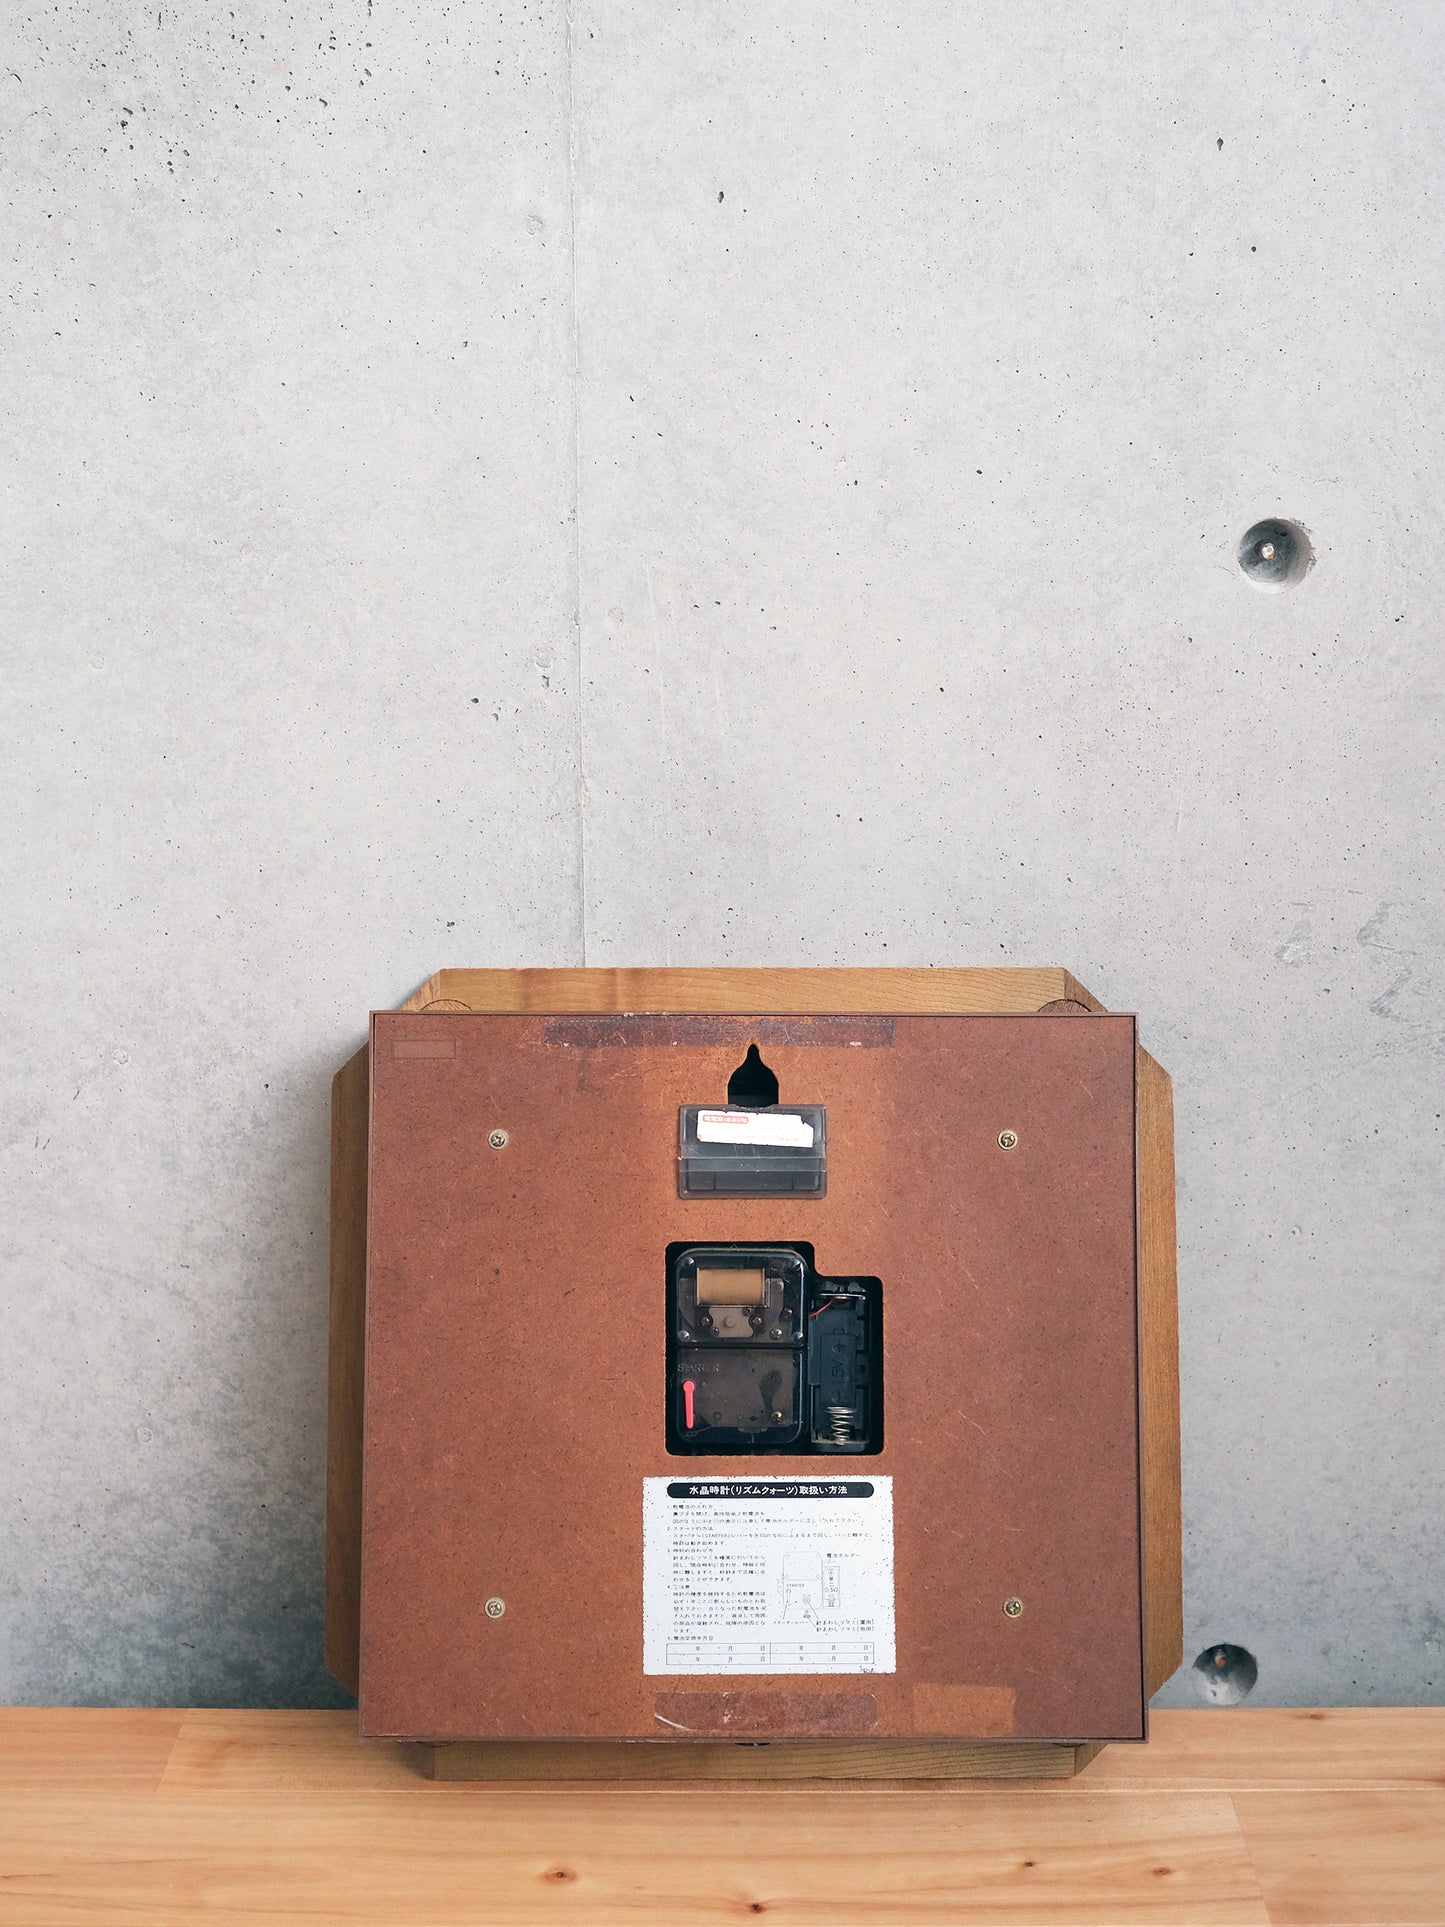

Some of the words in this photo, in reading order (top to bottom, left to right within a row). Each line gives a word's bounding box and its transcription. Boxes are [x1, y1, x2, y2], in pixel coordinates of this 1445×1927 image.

[689, 1485, 848, 1496] 水晶時計(リズムクォーツ)取扱い方法
